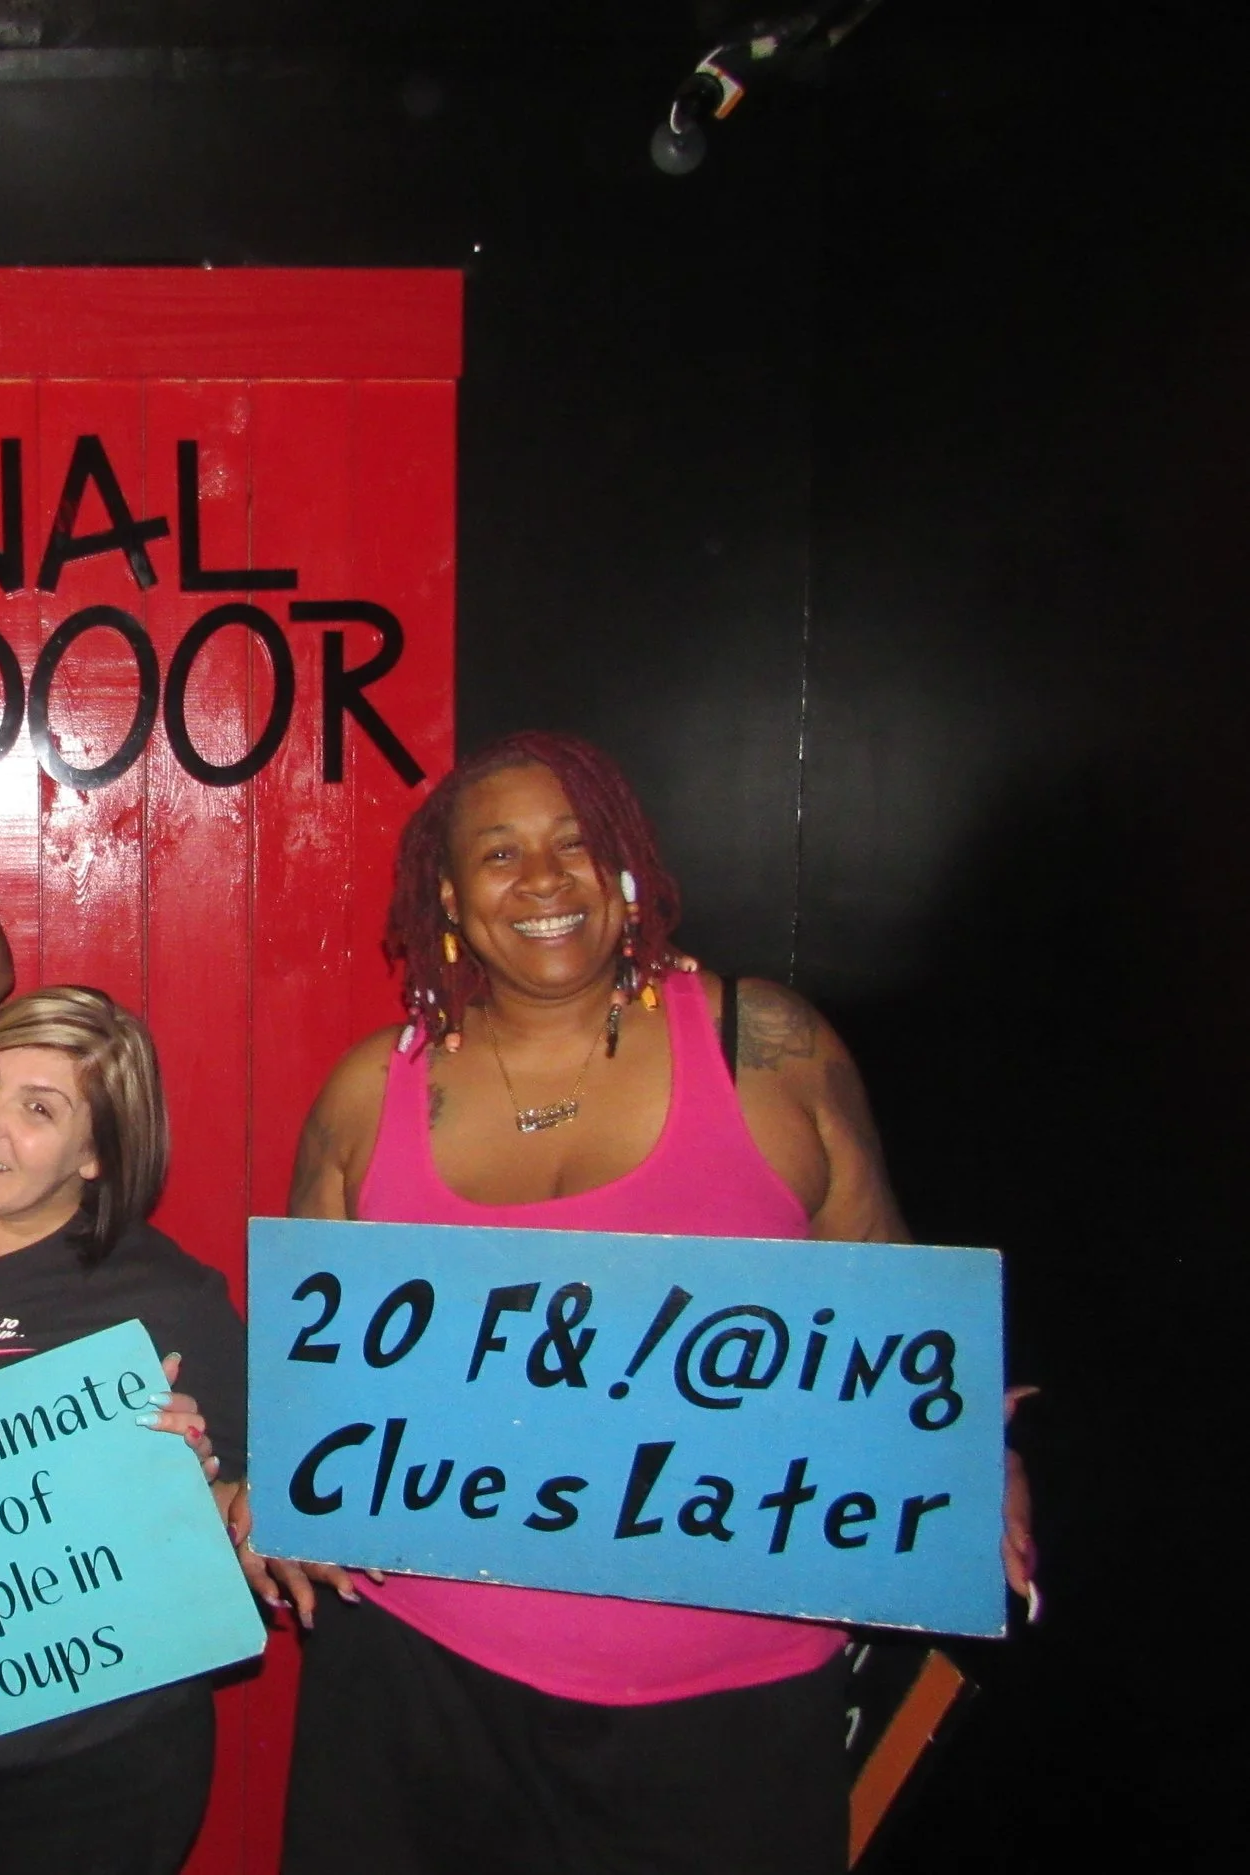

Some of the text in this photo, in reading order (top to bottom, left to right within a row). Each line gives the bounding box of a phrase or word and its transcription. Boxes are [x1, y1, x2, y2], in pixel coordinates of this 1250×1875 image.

[0, 1317, 20, 1330] TO
[287, 1271, 435, 1369] 20
[0, 1469, 54, 1536] of
[288, 1417, 952, 1555] Clues Later
[66, 1543, 124, 1595] in
